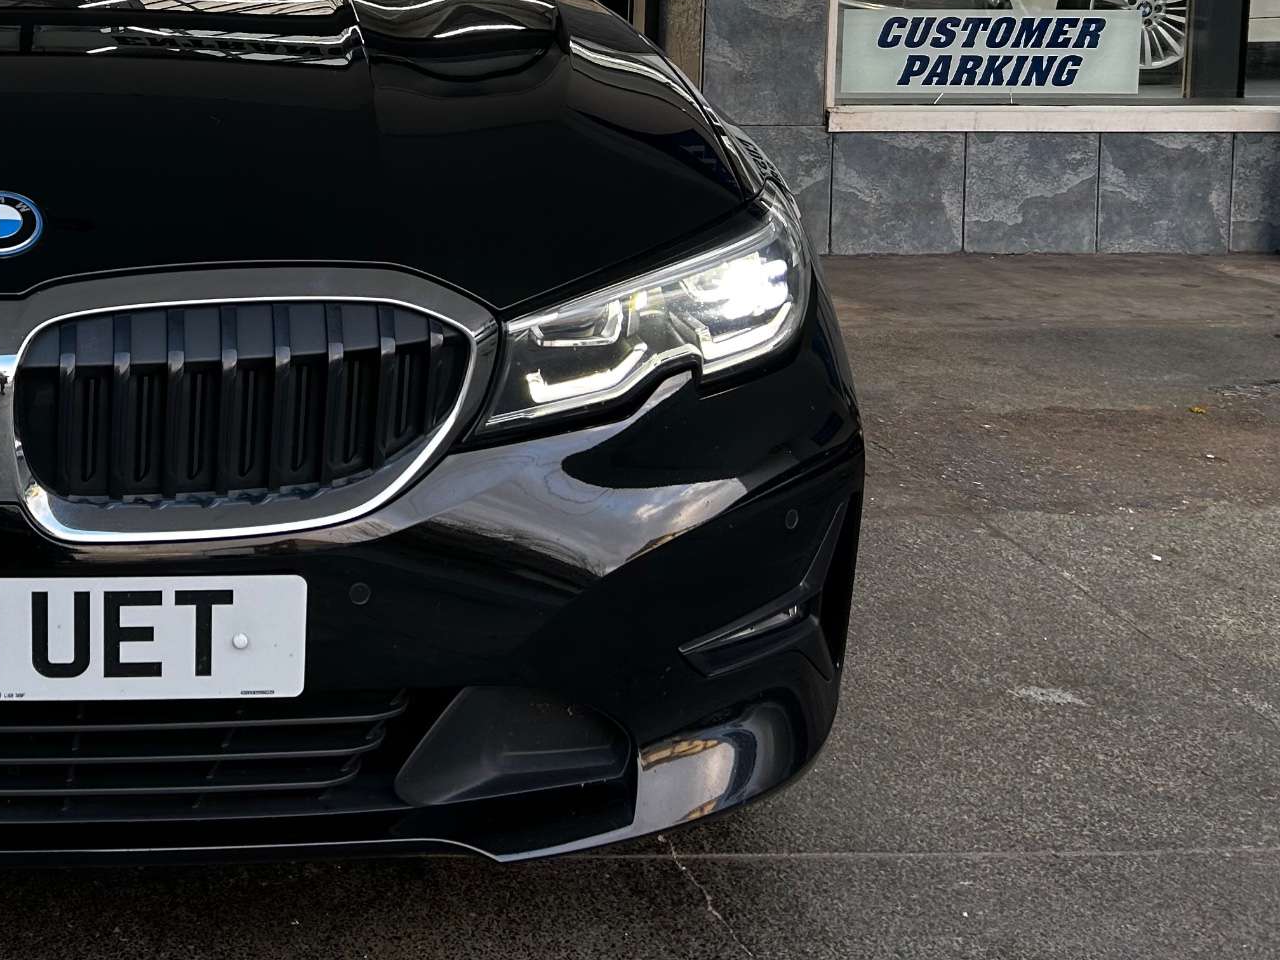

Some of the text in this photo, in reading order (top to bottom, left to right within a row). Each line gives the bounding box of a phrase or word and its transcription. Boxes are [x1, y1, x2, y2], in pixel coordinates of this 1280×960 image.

[876, 16, 1107, 49] CUSTOMER
[896, 54, 1084, 87] PARKING
[31, 589, 234, 679] UET
